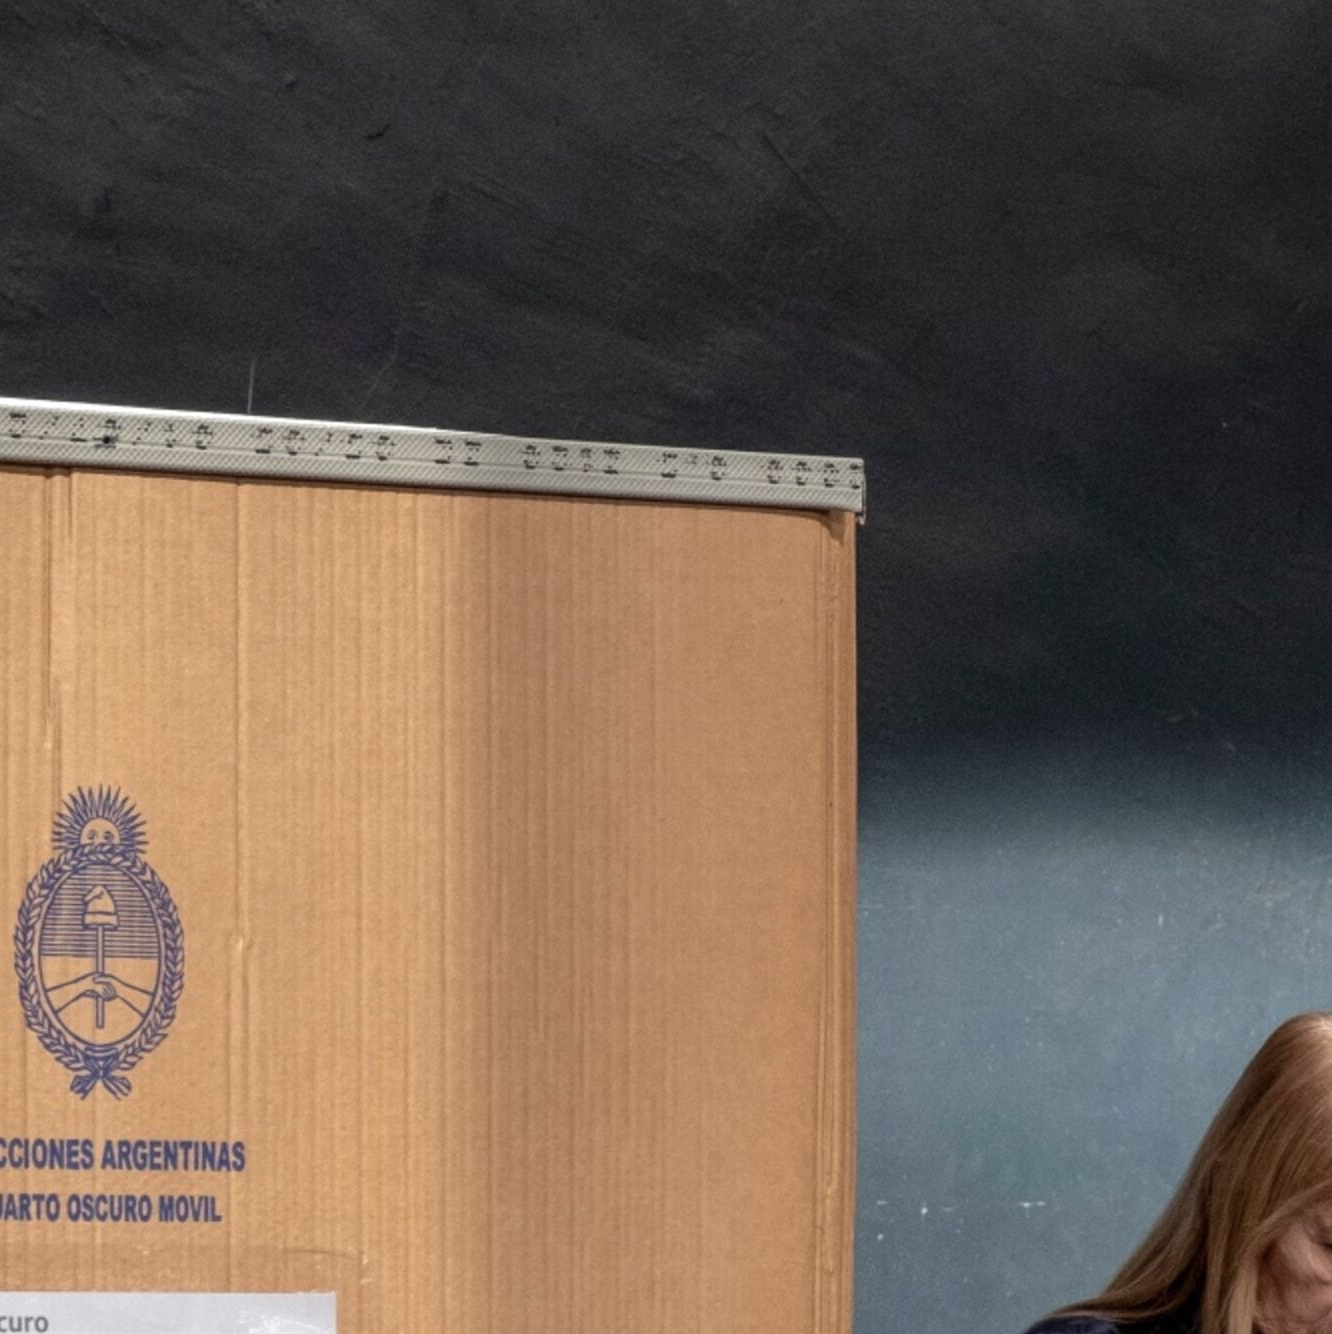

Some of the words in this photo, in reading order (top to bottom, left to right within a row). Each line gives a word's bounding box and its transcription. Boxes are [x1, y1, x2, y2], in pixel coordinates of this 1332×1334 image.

[100, 1139, 246, 1172] ARGENTINAS
[67, 1193, 151, 1223] OSCURO
[158, 1195, 222, 1223] MOVIL
